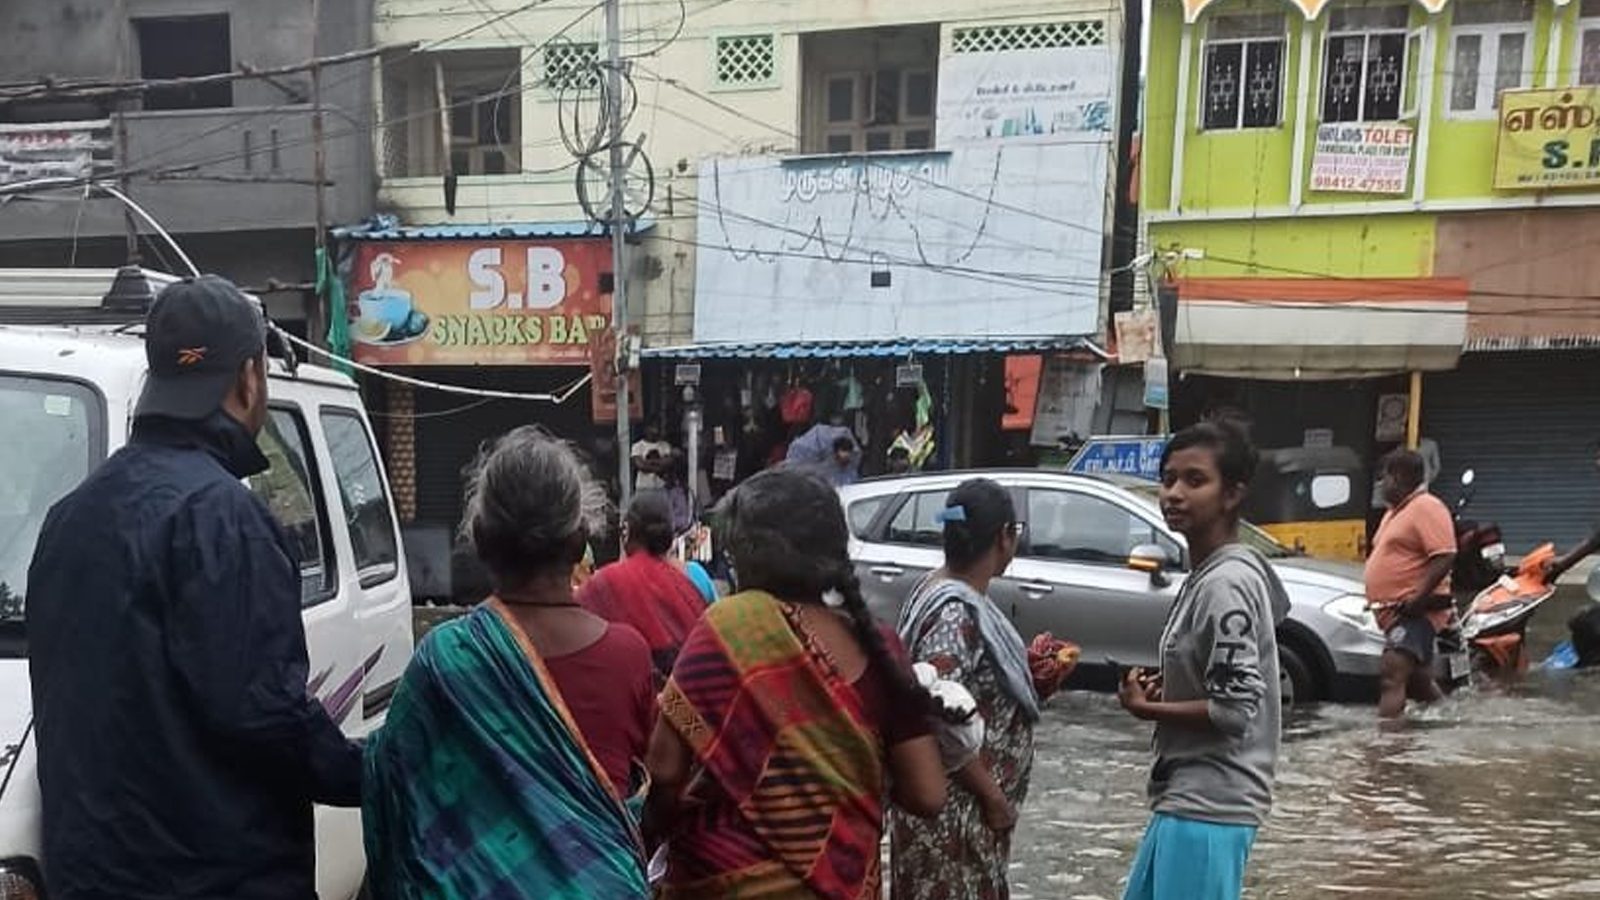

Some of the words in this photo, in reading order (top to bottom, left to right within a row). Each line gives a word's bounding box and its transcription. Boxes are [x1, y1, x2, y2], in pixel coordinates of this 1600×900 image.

[1504, 93, 1600, 131] எஸ்
[1365, 127, 1413, 144] TOLET
[467, 246, 566, 310] S.B
[434, 313, 542, 346] SNACKS
